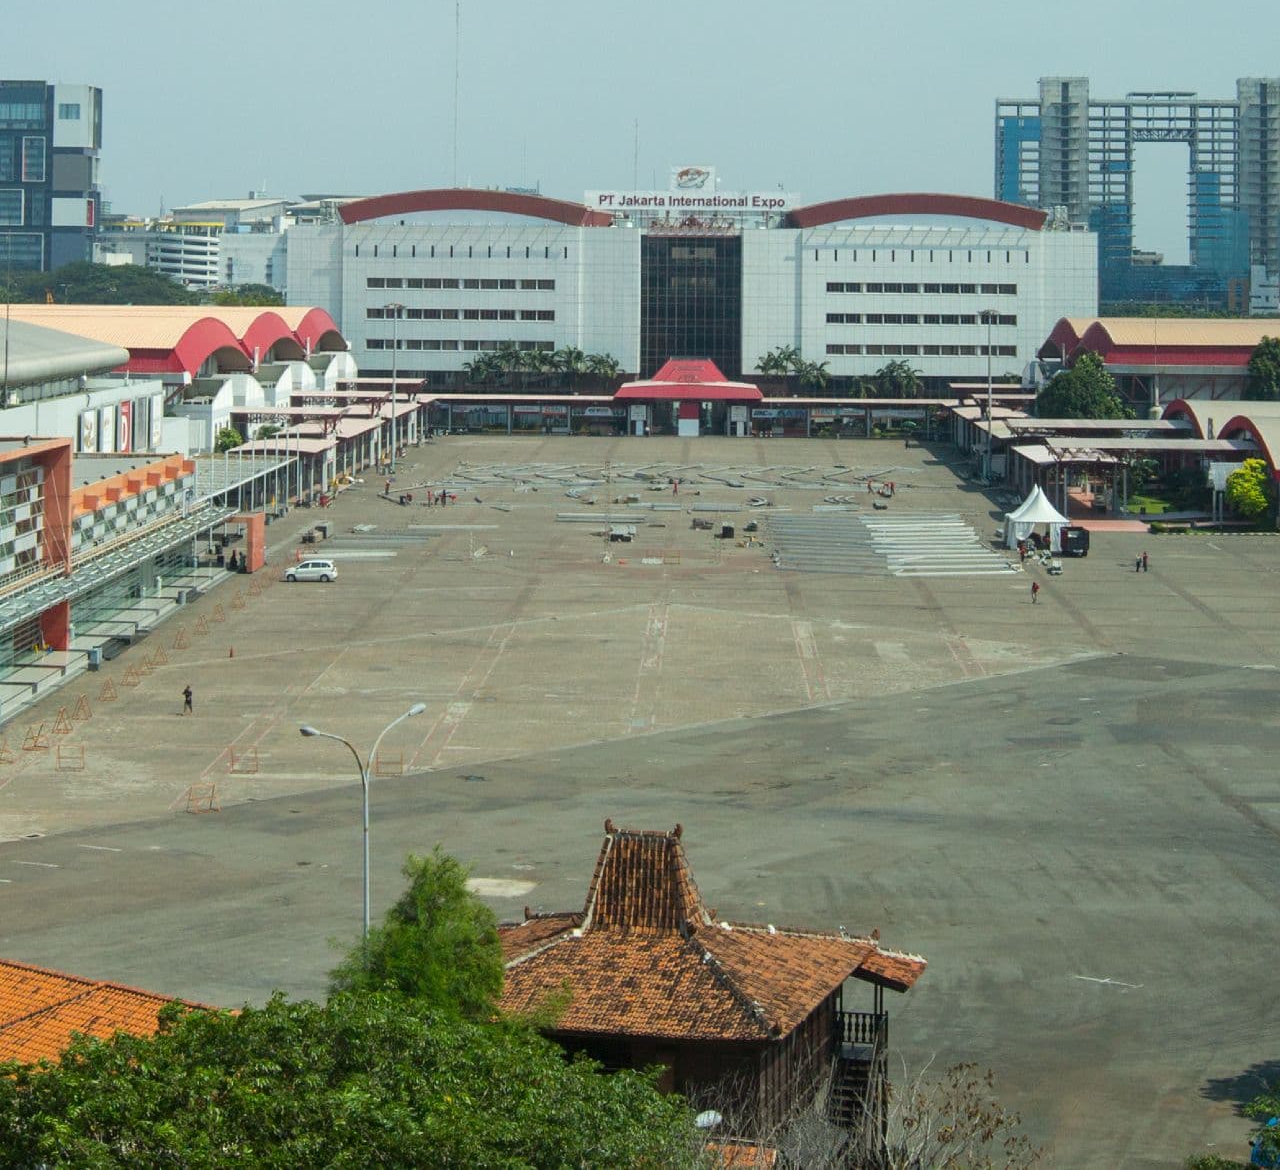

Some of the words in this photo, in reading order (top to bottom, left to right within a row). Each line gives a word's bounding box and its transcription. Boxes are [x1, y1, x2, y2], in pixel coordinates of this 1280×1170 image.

[599, 194, 615, 206] PT
[619, 194, 665, 207] Jakarta
[669, 195, 748, 208] International
[752, 196, 785, 209] Expo
